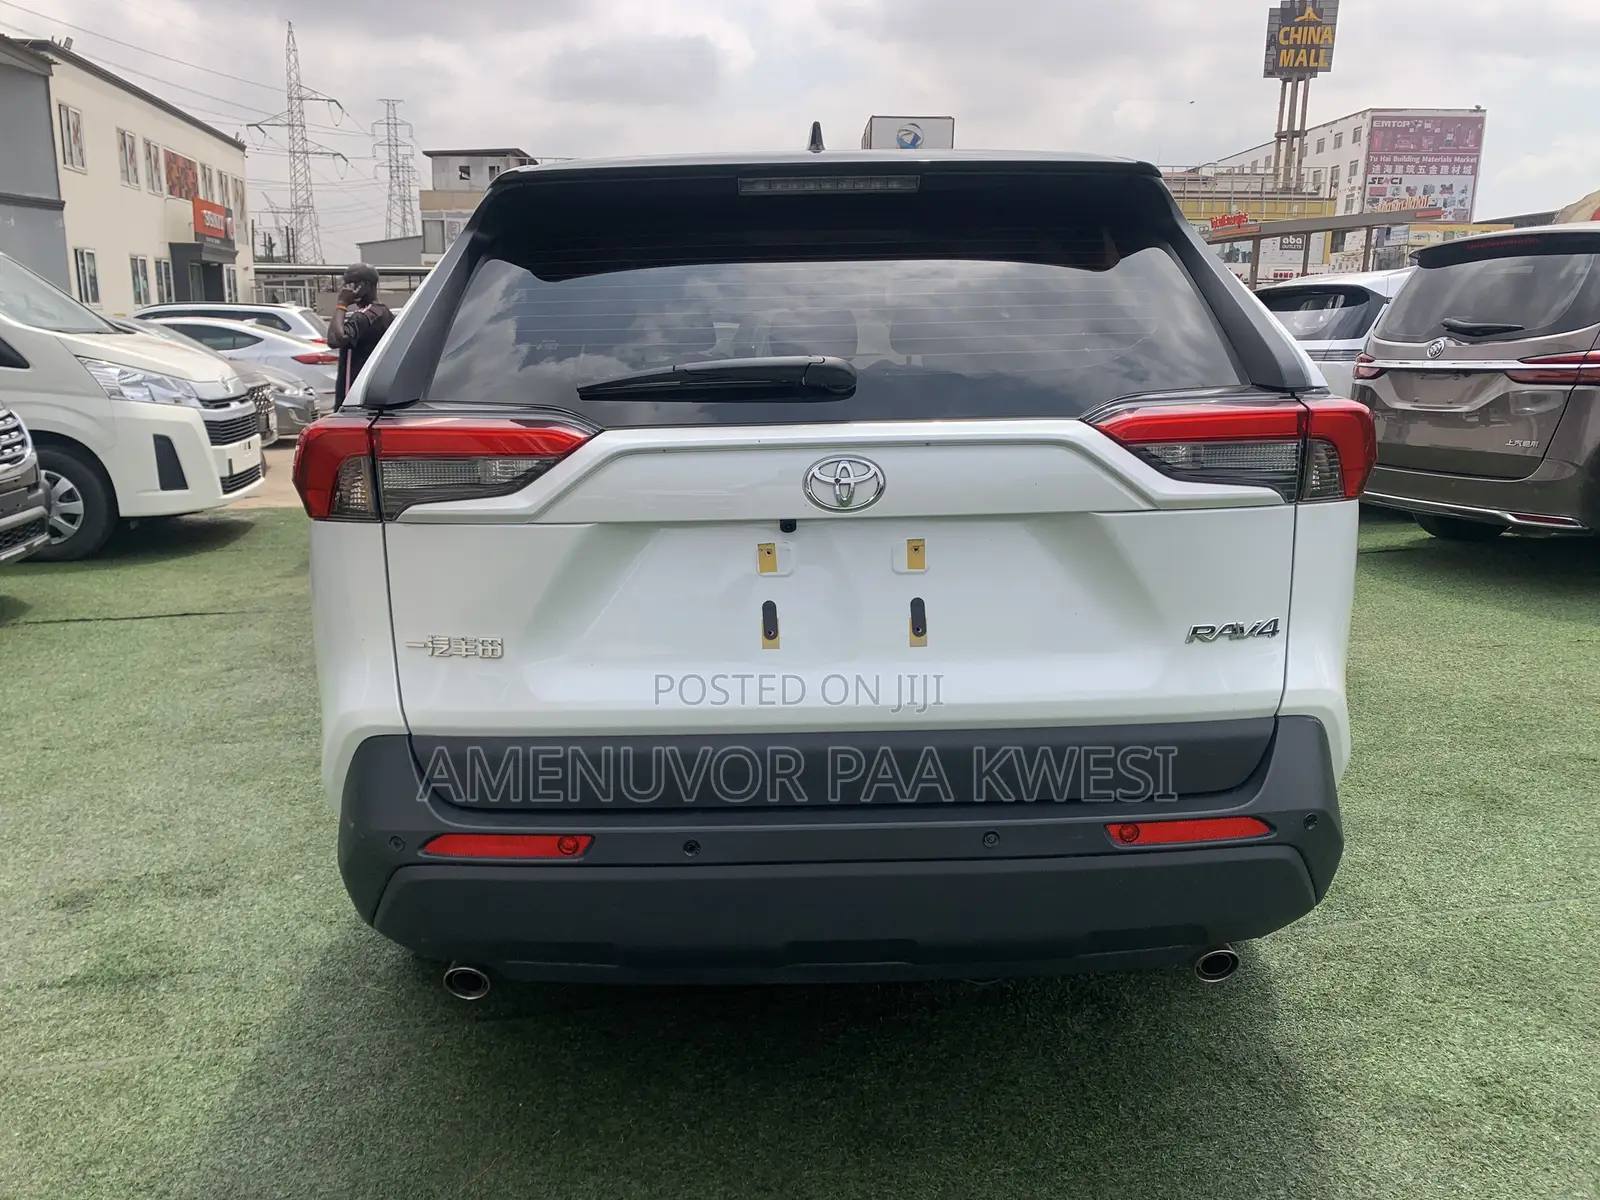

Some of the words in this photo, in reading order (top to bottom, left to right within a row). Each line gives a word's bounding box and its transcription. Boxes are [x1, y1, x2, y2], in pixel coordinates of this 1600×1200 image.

[1279, 25, 1333, 45] CHINA
[1279, 49, 1329, 67] MALL
[1373, 120, 1411, 128] EMTOP
[1393, 155, 1420, 164] Building
[1368, 177, 1403, 185] SENCI
[1282, 235, 1302, 244] aba
[1185, 616, 1280, 644] RAV4
